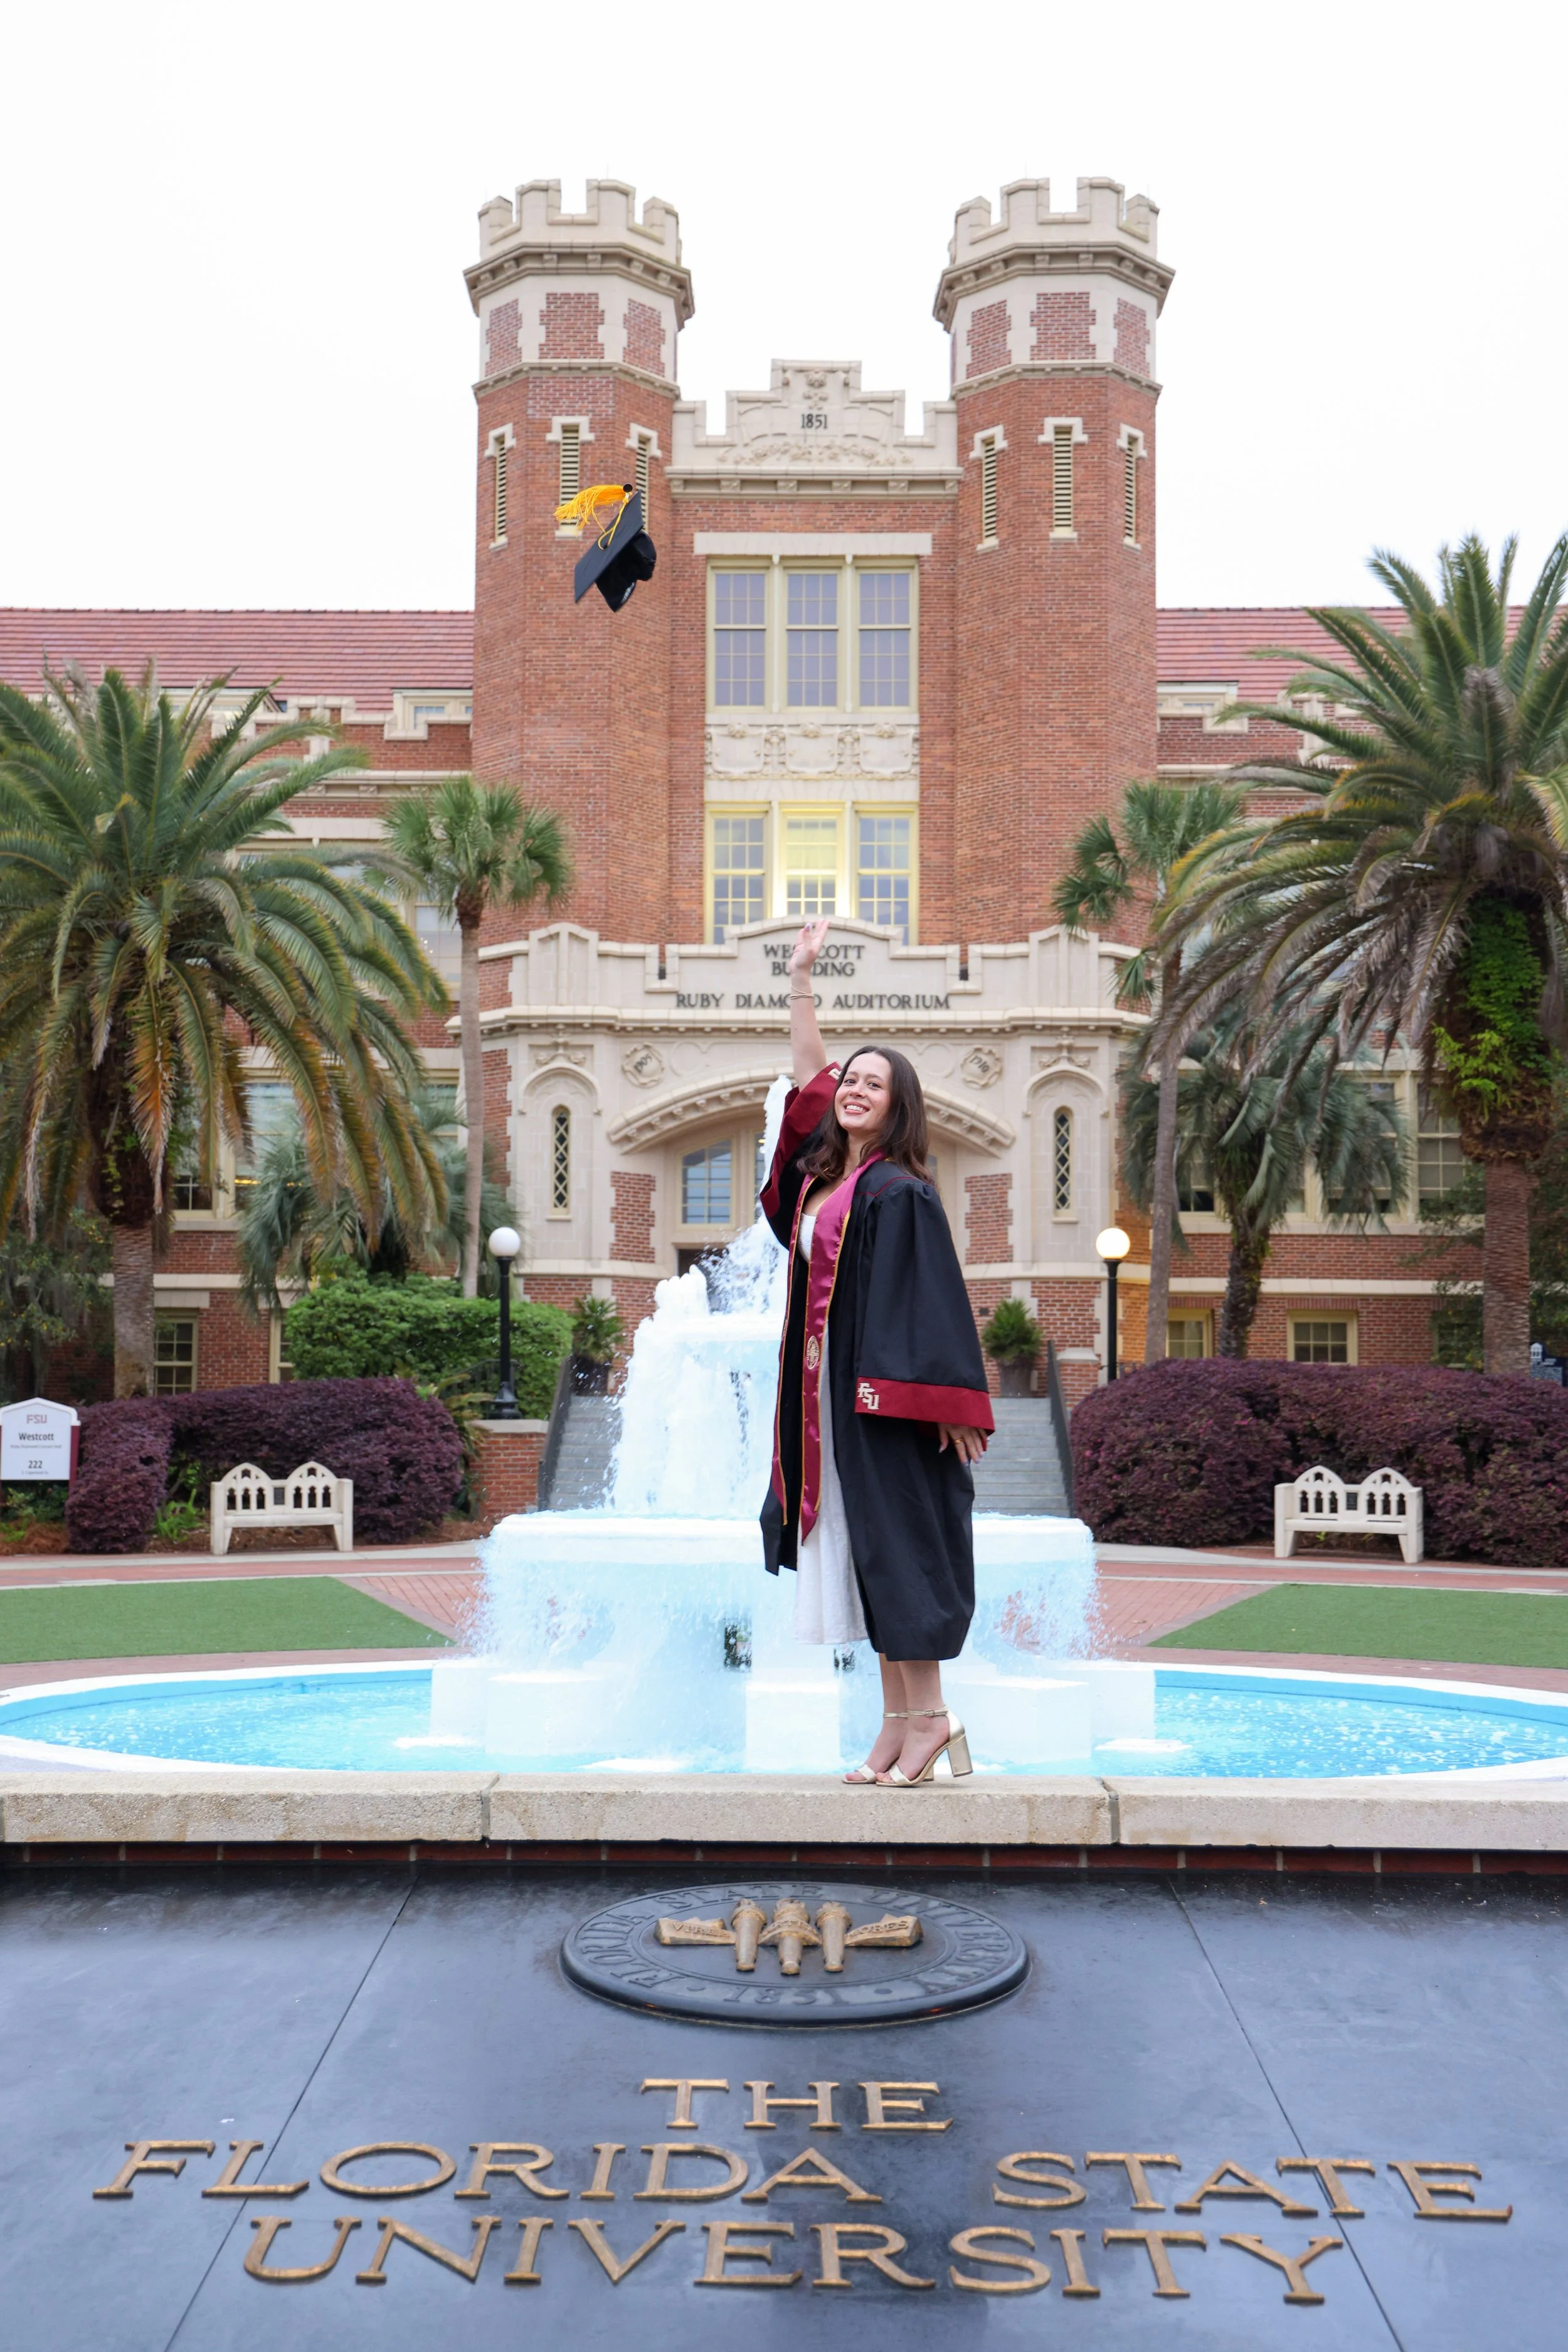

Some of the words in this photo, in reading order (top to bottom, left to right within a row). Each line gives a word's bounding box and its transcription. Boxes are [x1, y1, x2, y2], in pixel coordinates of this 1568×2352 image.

[801, 413, 827, 429] 1851
[771, 962, 855, 976] BUDING
[675, 994, 724, 1008] RUBY
[833, 994, 950, 1009] AUDITORIUM
[857, 1382, 880, 1410] FSU
[26, 1415, 47, 1424] FSU
[19, 1432, 54, 1441] Westcott
[28, 1461, 43, 1469] 222
[654, 1881, 823, 1908] STATE
[723, 1986, 850, 2005] 1851
[640, 2078, 953, 2131] THE
[92, 2139, 882, 2200] FLORIDA
[991, 2151, 1513, 2222] STATE
[243, 2216, 1343, 2304] UNIVERSITY
